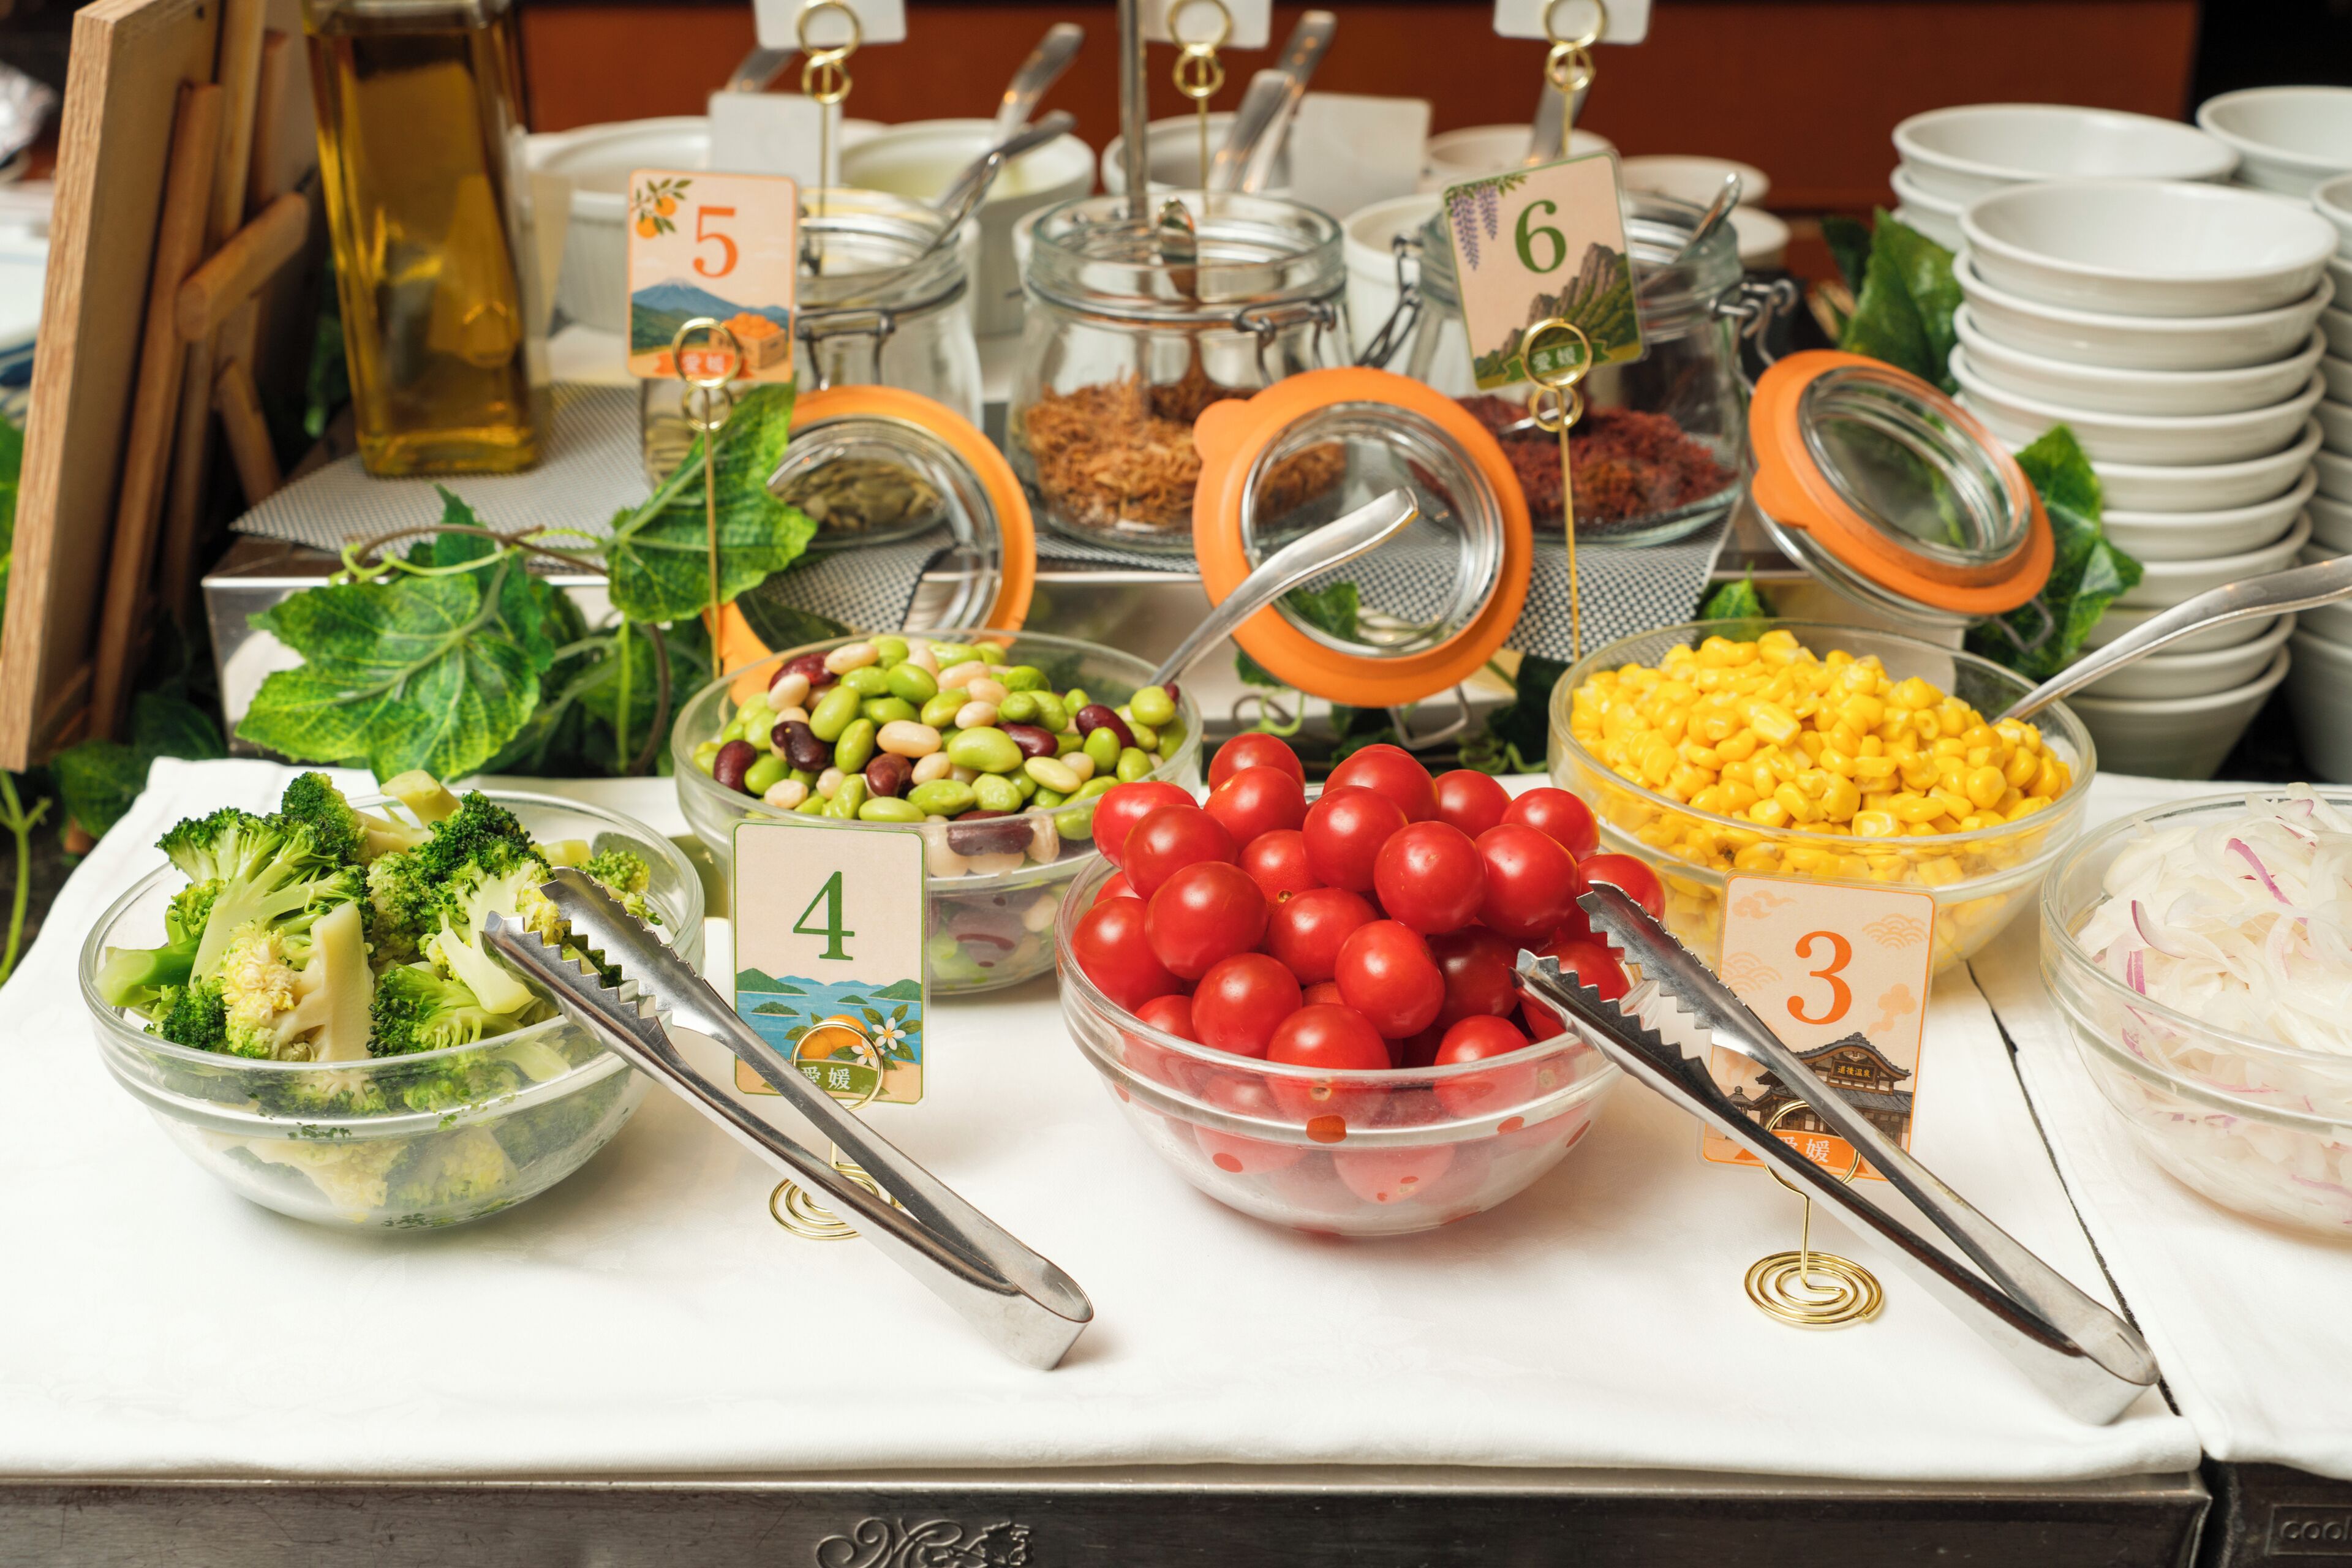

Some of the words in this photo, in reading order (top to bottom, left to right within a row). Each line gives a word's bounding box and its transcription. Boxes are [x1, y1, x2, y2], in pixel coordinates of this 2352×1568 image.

[692, 205, 739, 279] 5
[1515, 199, 1567, 274] 6
[1532, 345, 1578, 372] 愛媛
[793, 870, 855, 961] 4
[1787, 930, 1852, 1025] 3
